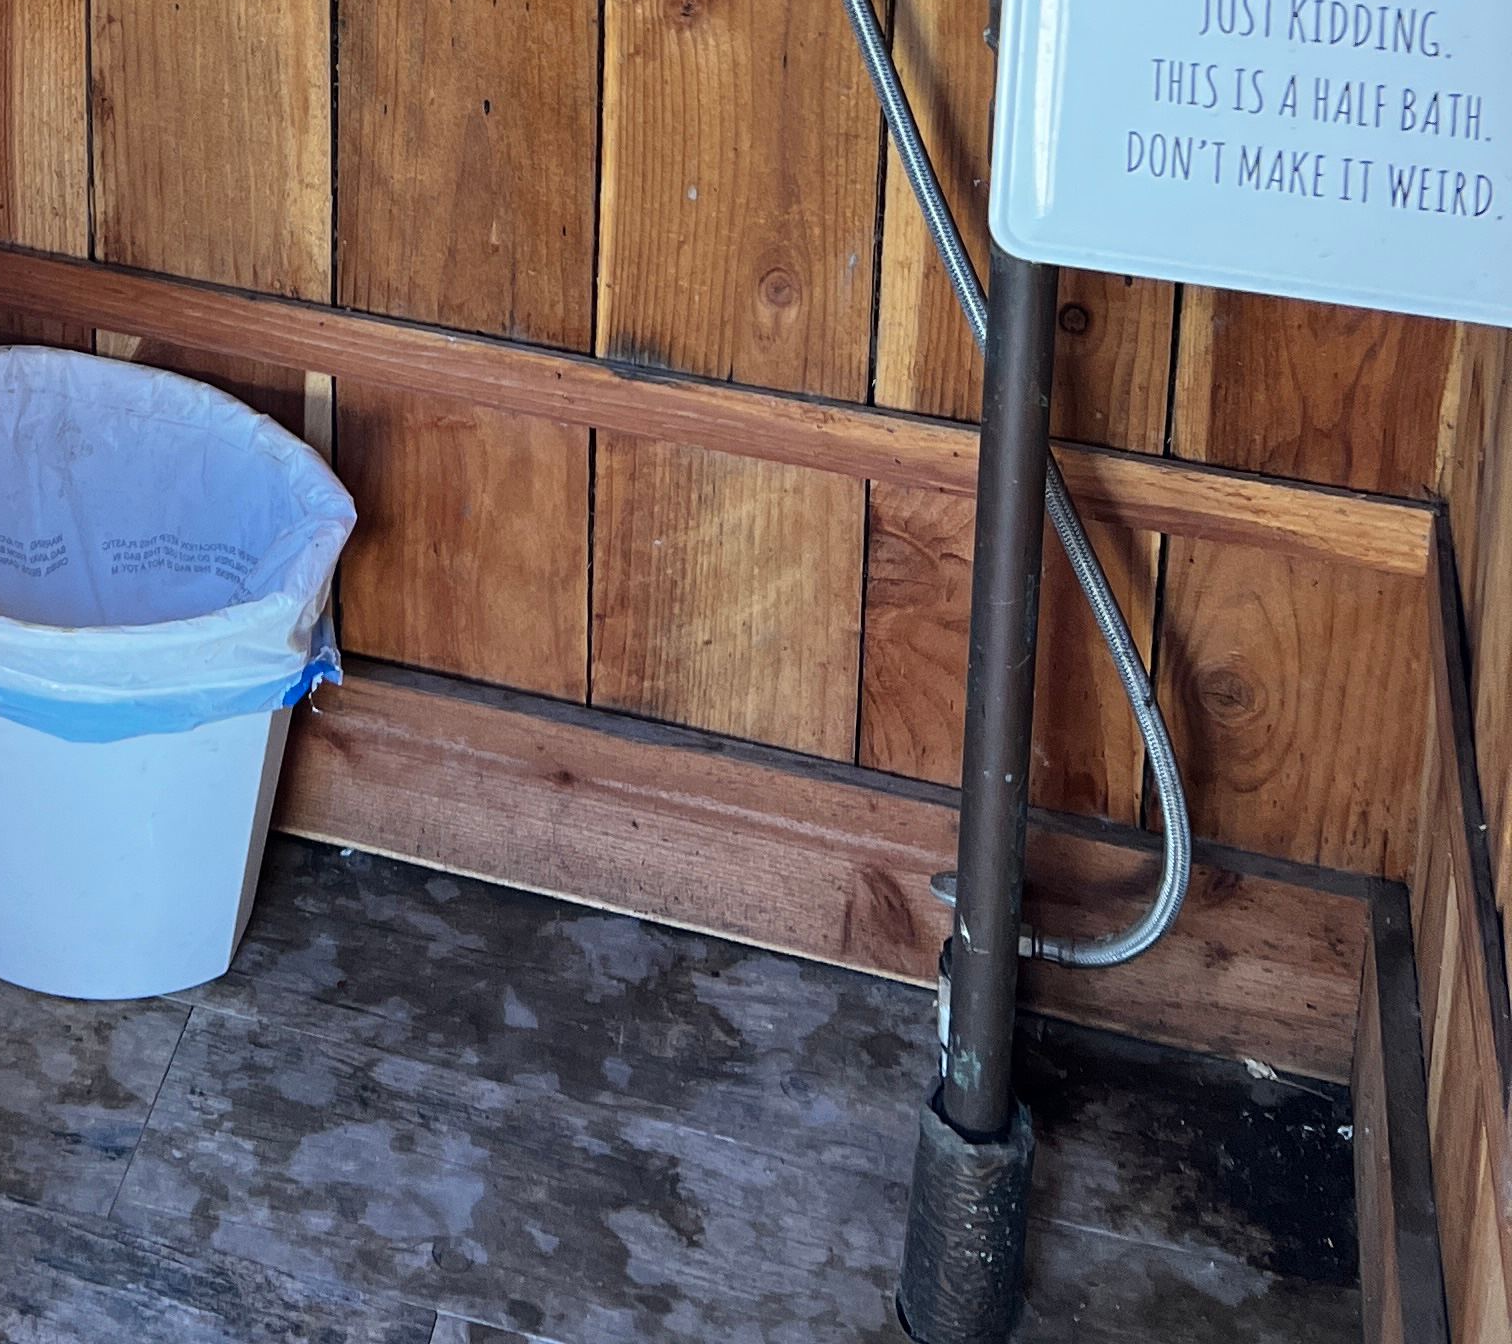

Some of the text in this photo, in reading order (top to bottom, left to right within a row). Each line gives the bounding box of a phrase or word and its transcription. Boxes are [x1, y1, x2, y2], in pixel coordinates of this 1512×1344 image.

[1151, 58, 1492, 142] THIS IS A HALF BATH.
[1125, 130, 1504, 222] DON'T MAKE IT WEIRD.
